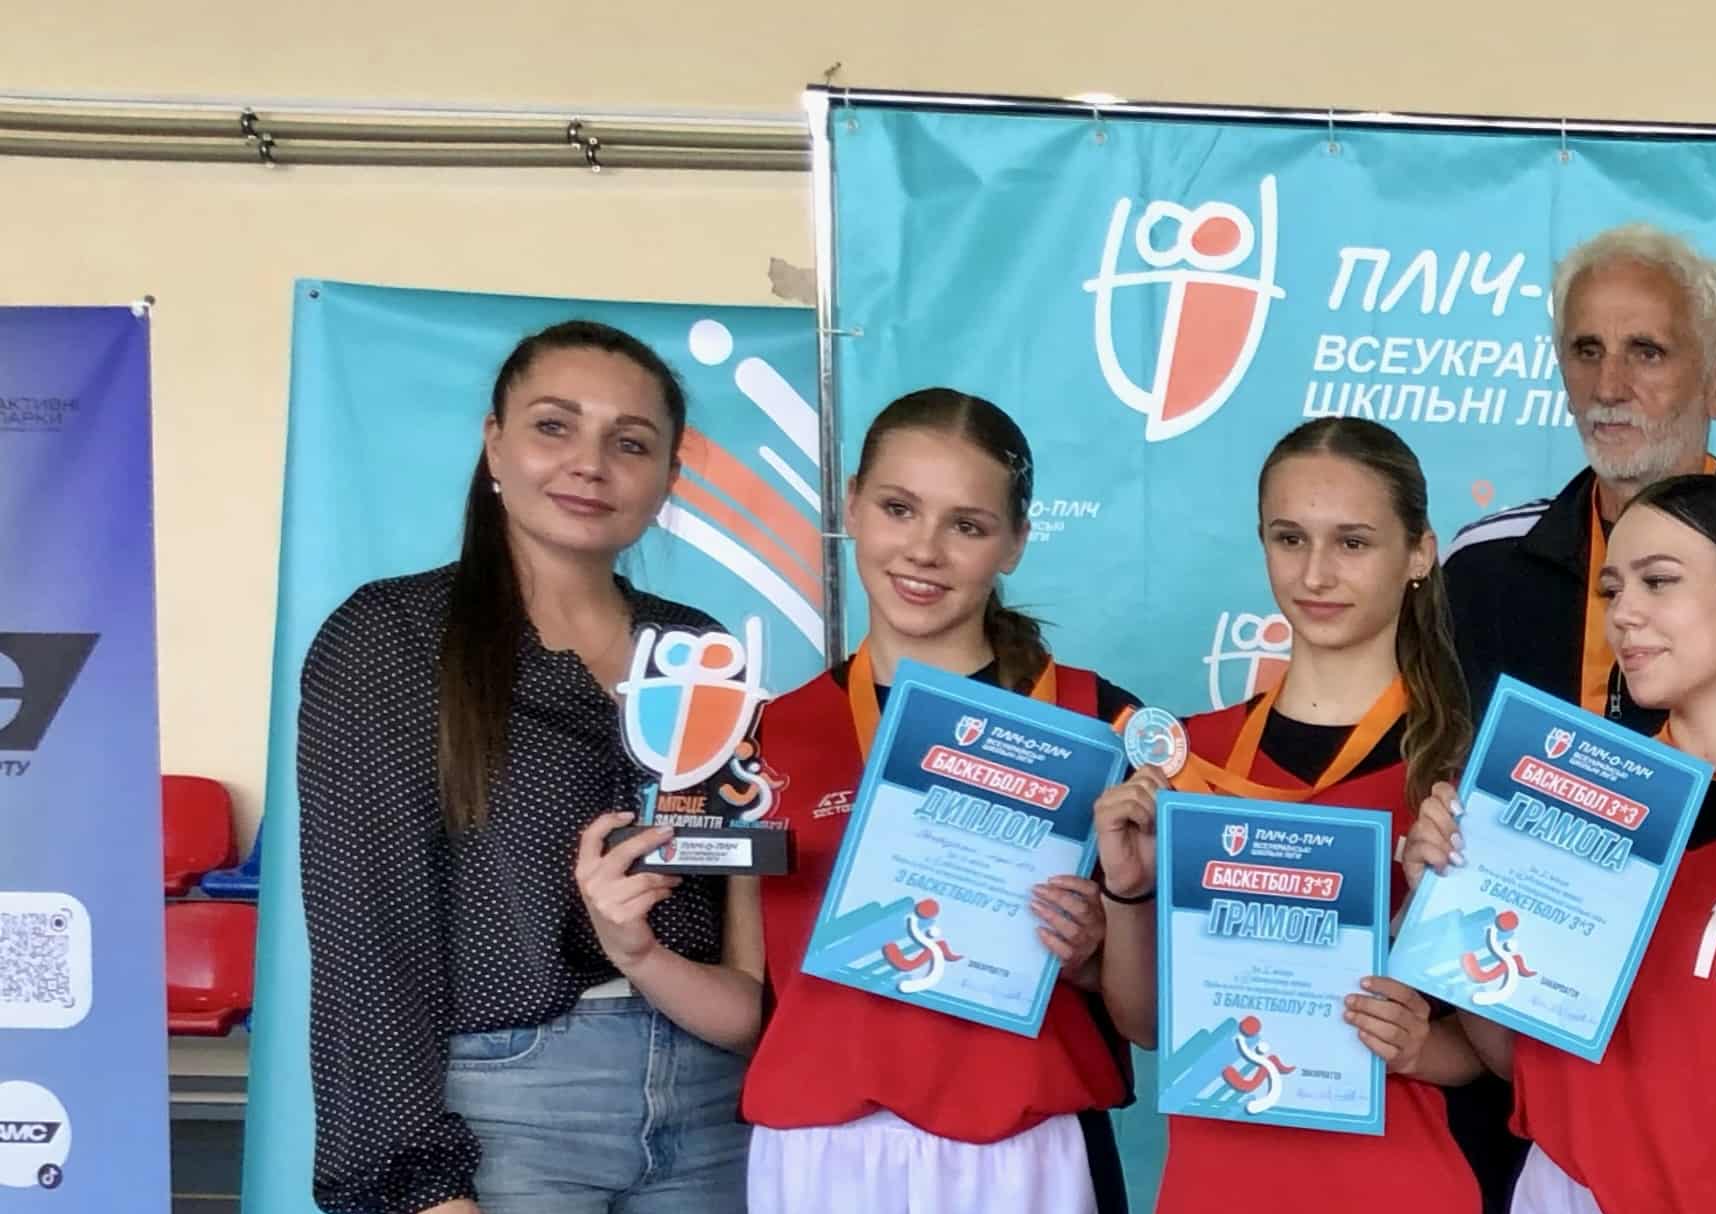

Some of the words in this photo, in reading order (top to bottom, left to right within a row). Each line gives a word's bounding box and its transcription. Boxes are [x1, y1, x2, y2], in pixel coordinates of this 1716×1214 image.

[1312, 334, 1560, 380] ВСЕУКРАЇ
[1302, 380, 1508, 426] ШКІЛЬНІ
[1515, 389, 1576, 428] ЛІ
[1028, 500, 1101, 518] О-ПЛІЧ
[0, 760, 31, 776] ТУ
[932, 752, 1026, 795] БАСКЕТБОЛ
[1520, 762, 1606, 814] БАСКЕТБОЛ
[812, 804, 851, 819] SECTO
[913, 784, 1055, 849] ДИПЛОМ
[1500, 791, 1634, 873] ГРАМОТА
[1212, 866, 1302, 894] БАСКЕТБОЛ
[1208, 898, 1339, 946] ГРАМОТА
